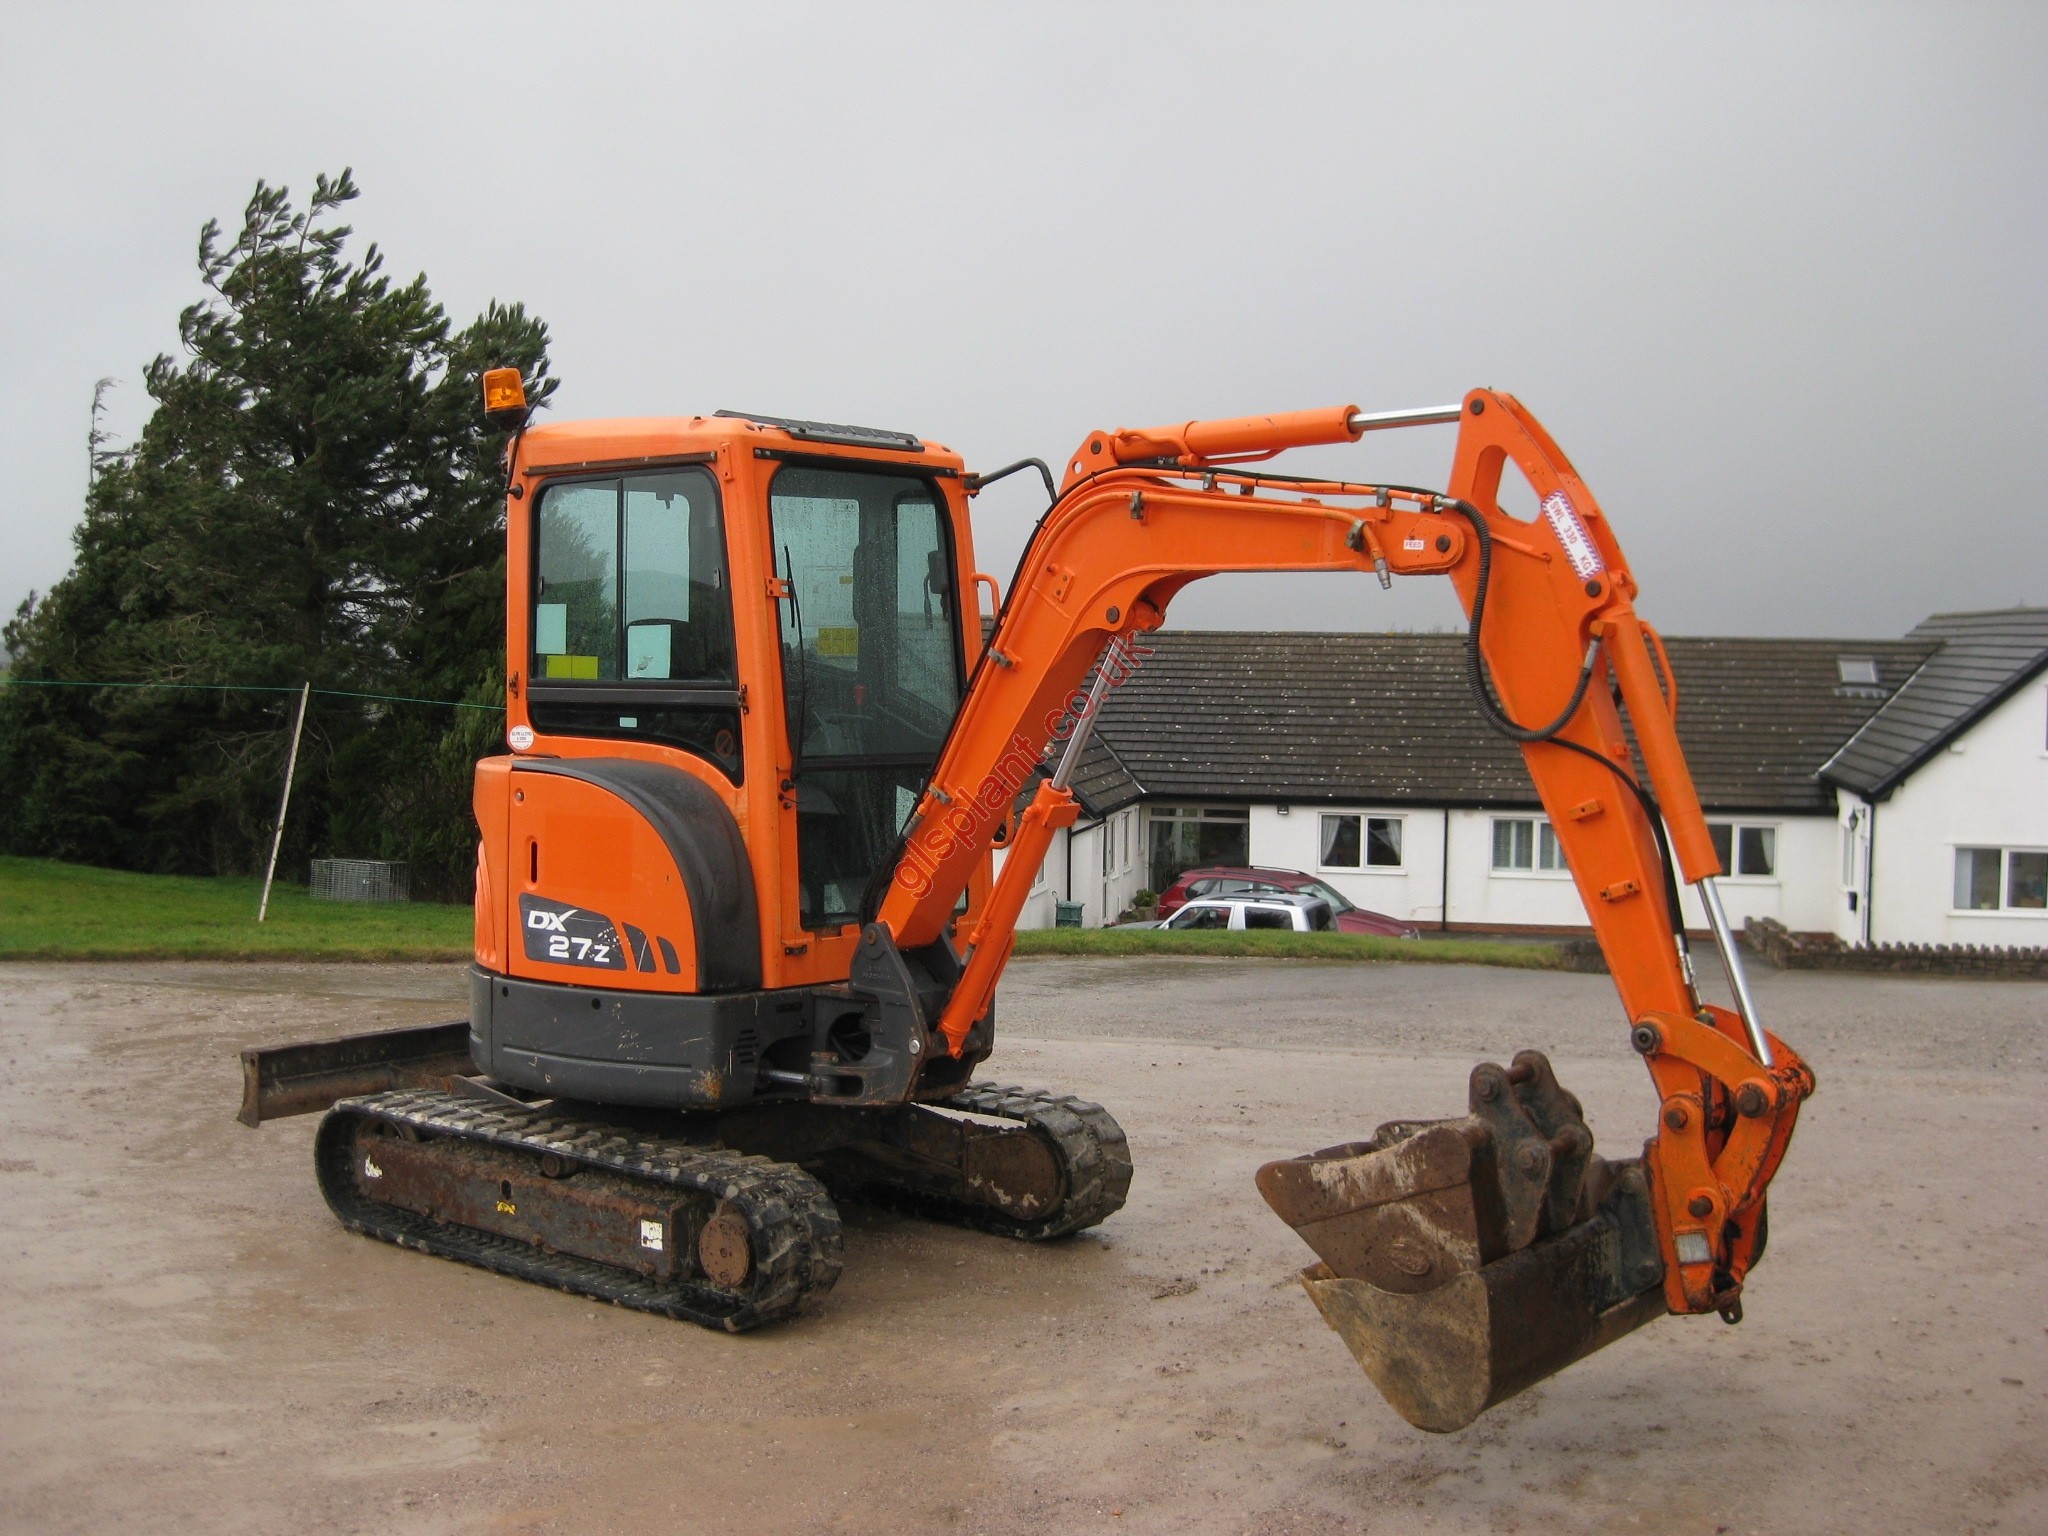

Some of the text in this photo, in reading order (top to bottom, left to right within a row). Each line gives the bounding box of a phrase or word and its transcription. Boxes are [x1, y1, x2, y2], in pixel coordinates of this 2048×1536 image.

[1550, 501, 1592, 571] SWL 330 KG
[527, 909, 579, 932] DX
